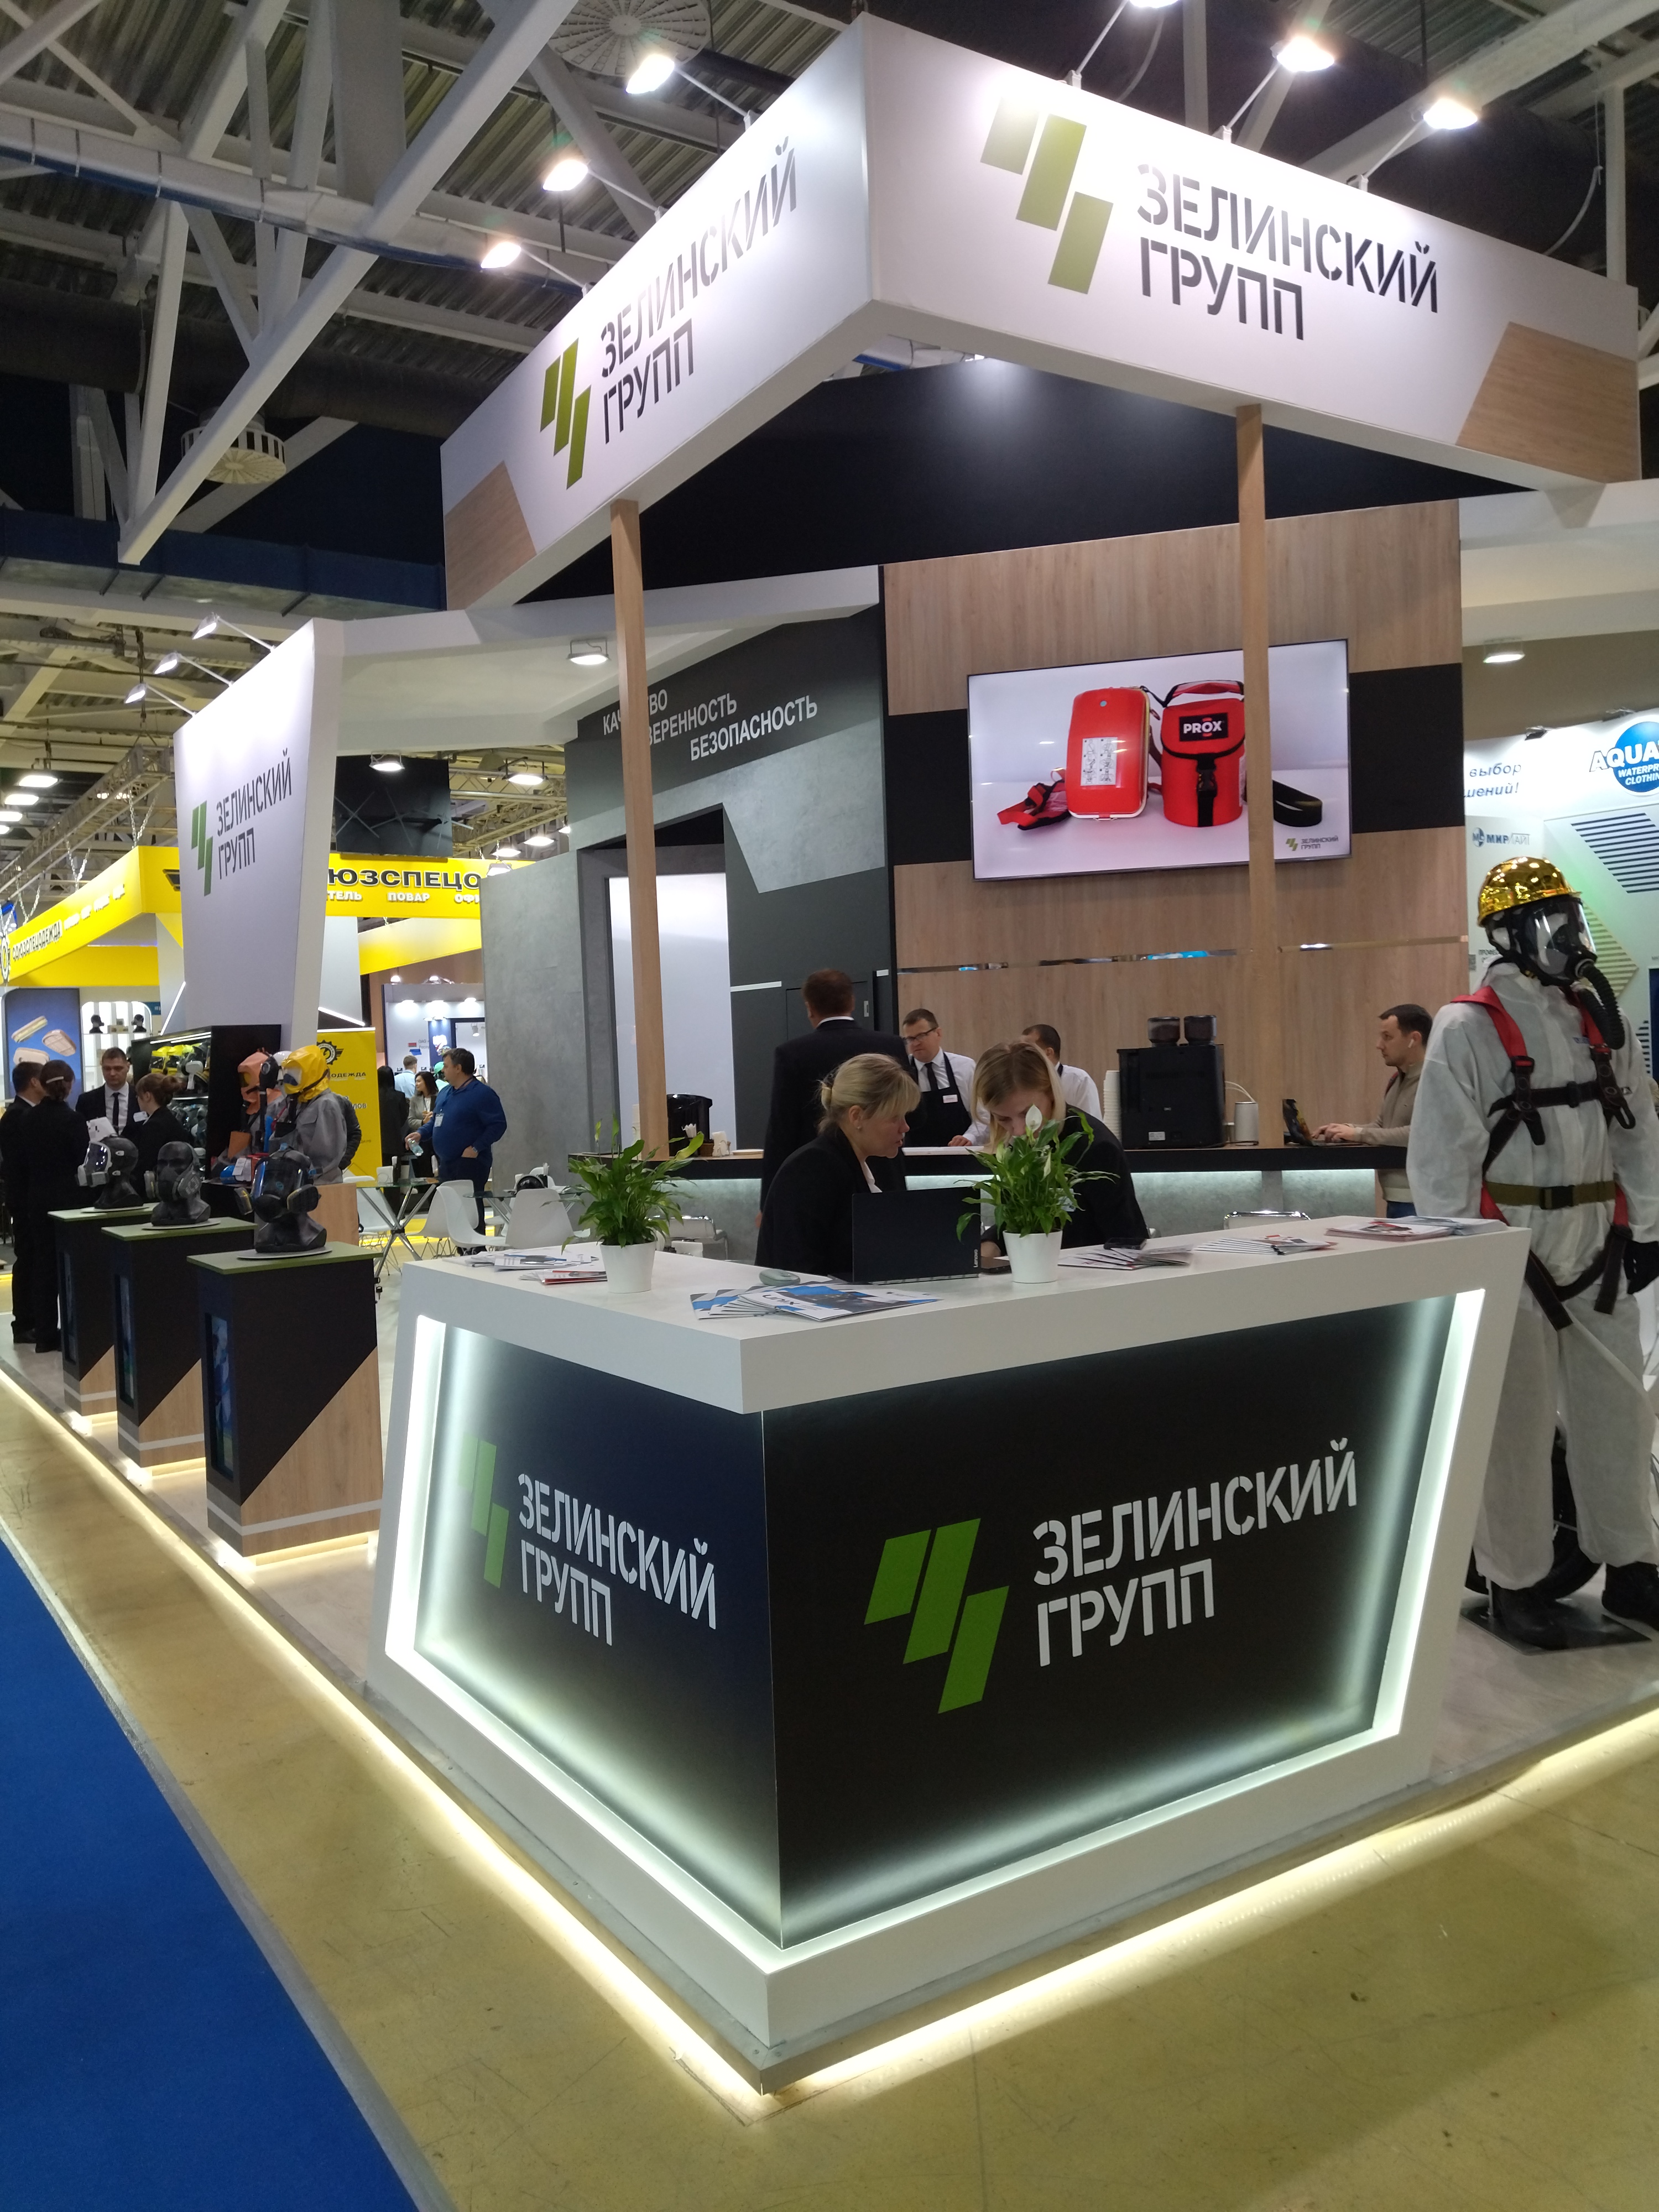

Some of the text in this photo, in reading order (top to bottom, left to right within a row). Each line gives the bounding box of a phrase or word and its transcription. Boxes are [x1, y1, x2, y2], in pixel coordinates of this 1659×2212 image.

[601, 135, 797, 378] ЗЕЛИНСКИЙ
[1137, 164, 1438, 313] ЗЕЛИНСКИЙ
[1140, 237, 1304, 341] ГРУПП
[603, 317, 695, 445] ГРУПП
[603, 689, 668, 735] КАВО
[690, 695, 818, 761] БЕЗОПАСНОСТЬ
[1183, 720, 1222, 734] PROX
[216, 747, 291, 837] ЗЕЛИНСКИЙ
[1469, 763, 1521, 777] выбор
[218, 827, 255, 880] ГРУПП
[1301, 836, 1338, 844] ЗЕЛИНСКИЙ
[12, 921, 62, 961] СОЮЗСПЕЦОДЕЖДА
[388, 891, 430, 902] ПОВАР
[518, 1473, 716, 1630] ЗЕЛИНСКИЙ
[1032, 1437, 1357, 1586] ЗЕЛИНСКИЙ
[521, 1539, 612, 1646] ГРУПП
[1037, 1558, 1214, 1667] ГРУПП
